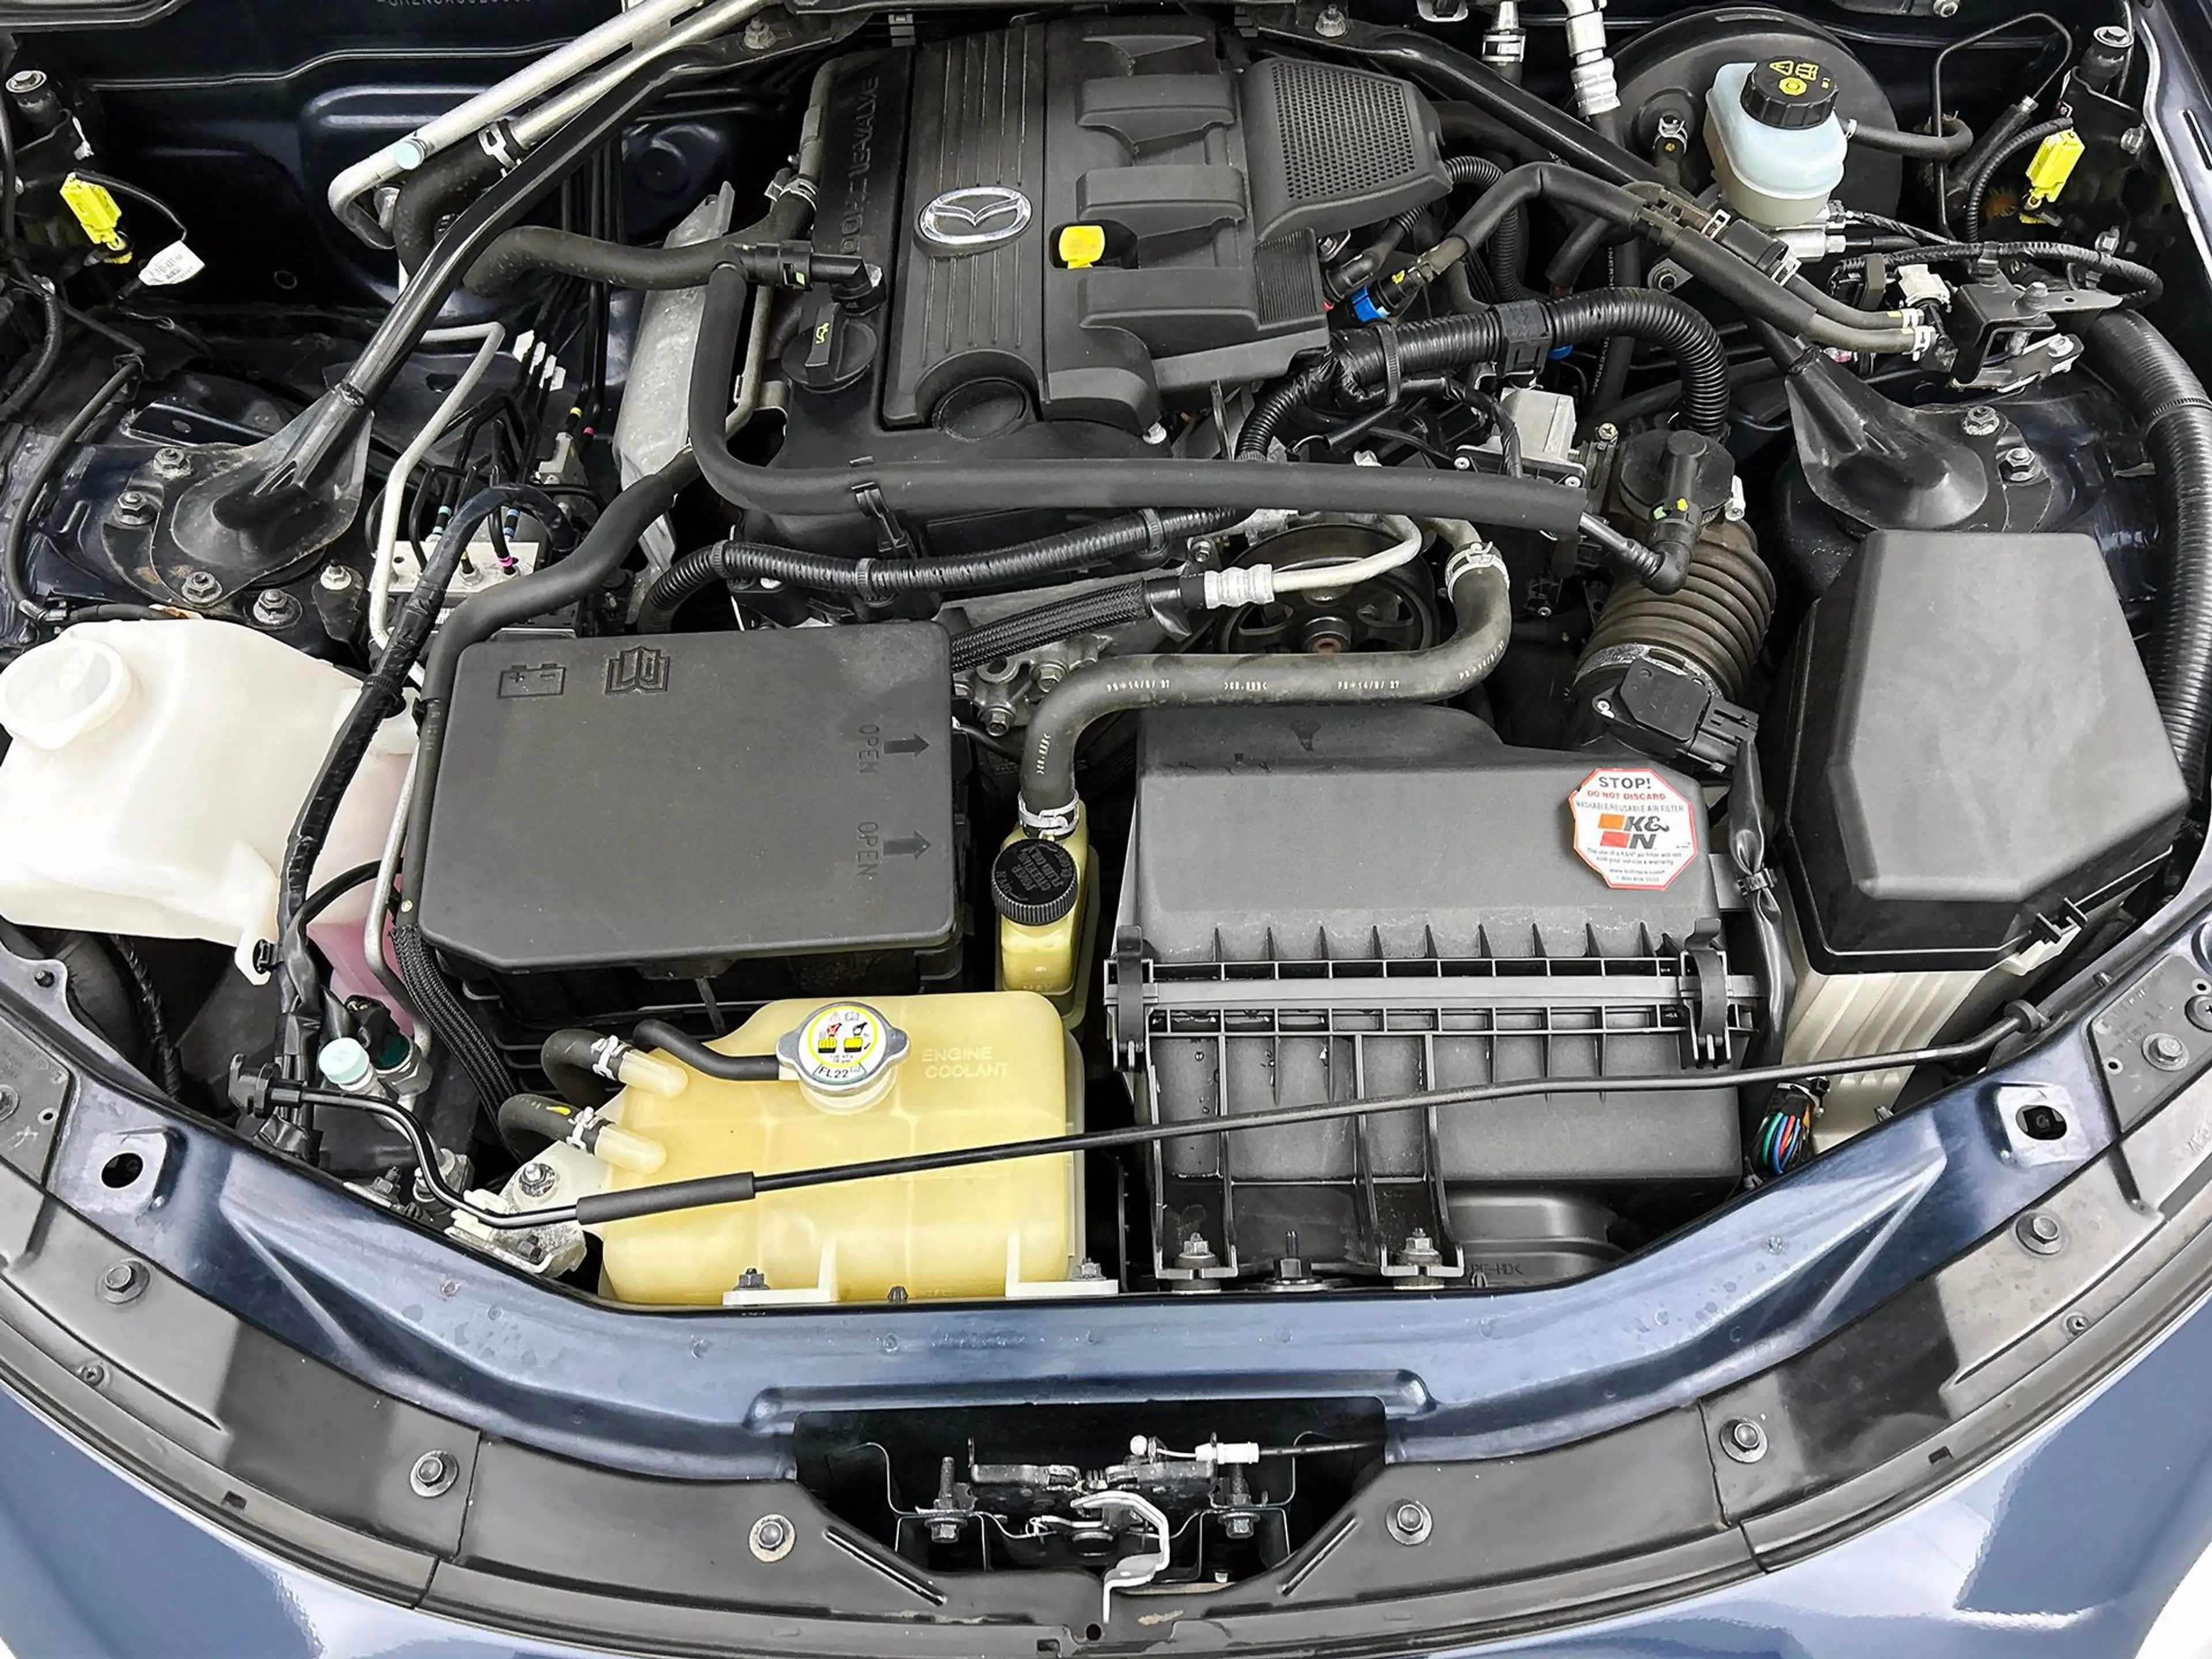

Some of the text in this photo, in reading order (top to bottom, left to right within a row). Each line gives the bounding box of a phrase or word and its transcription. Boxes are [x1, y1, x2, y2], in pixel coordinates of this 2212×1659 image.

[857, 724, 881, 774] OPEN
[1598, 777, 1652, 790] STOP!
[1587, 790, 1600, 798] DO
[1603, 791, 1620, 800] NOT
[1647, 804, 1659, 812] AIR
[856, 821, 880, 877] OPEN
[922, 1046, 993, 1062] ENGINE
[818, 1066, 849, 1079] FL22
[924, 1062, 1010, 1079] COOLANT
